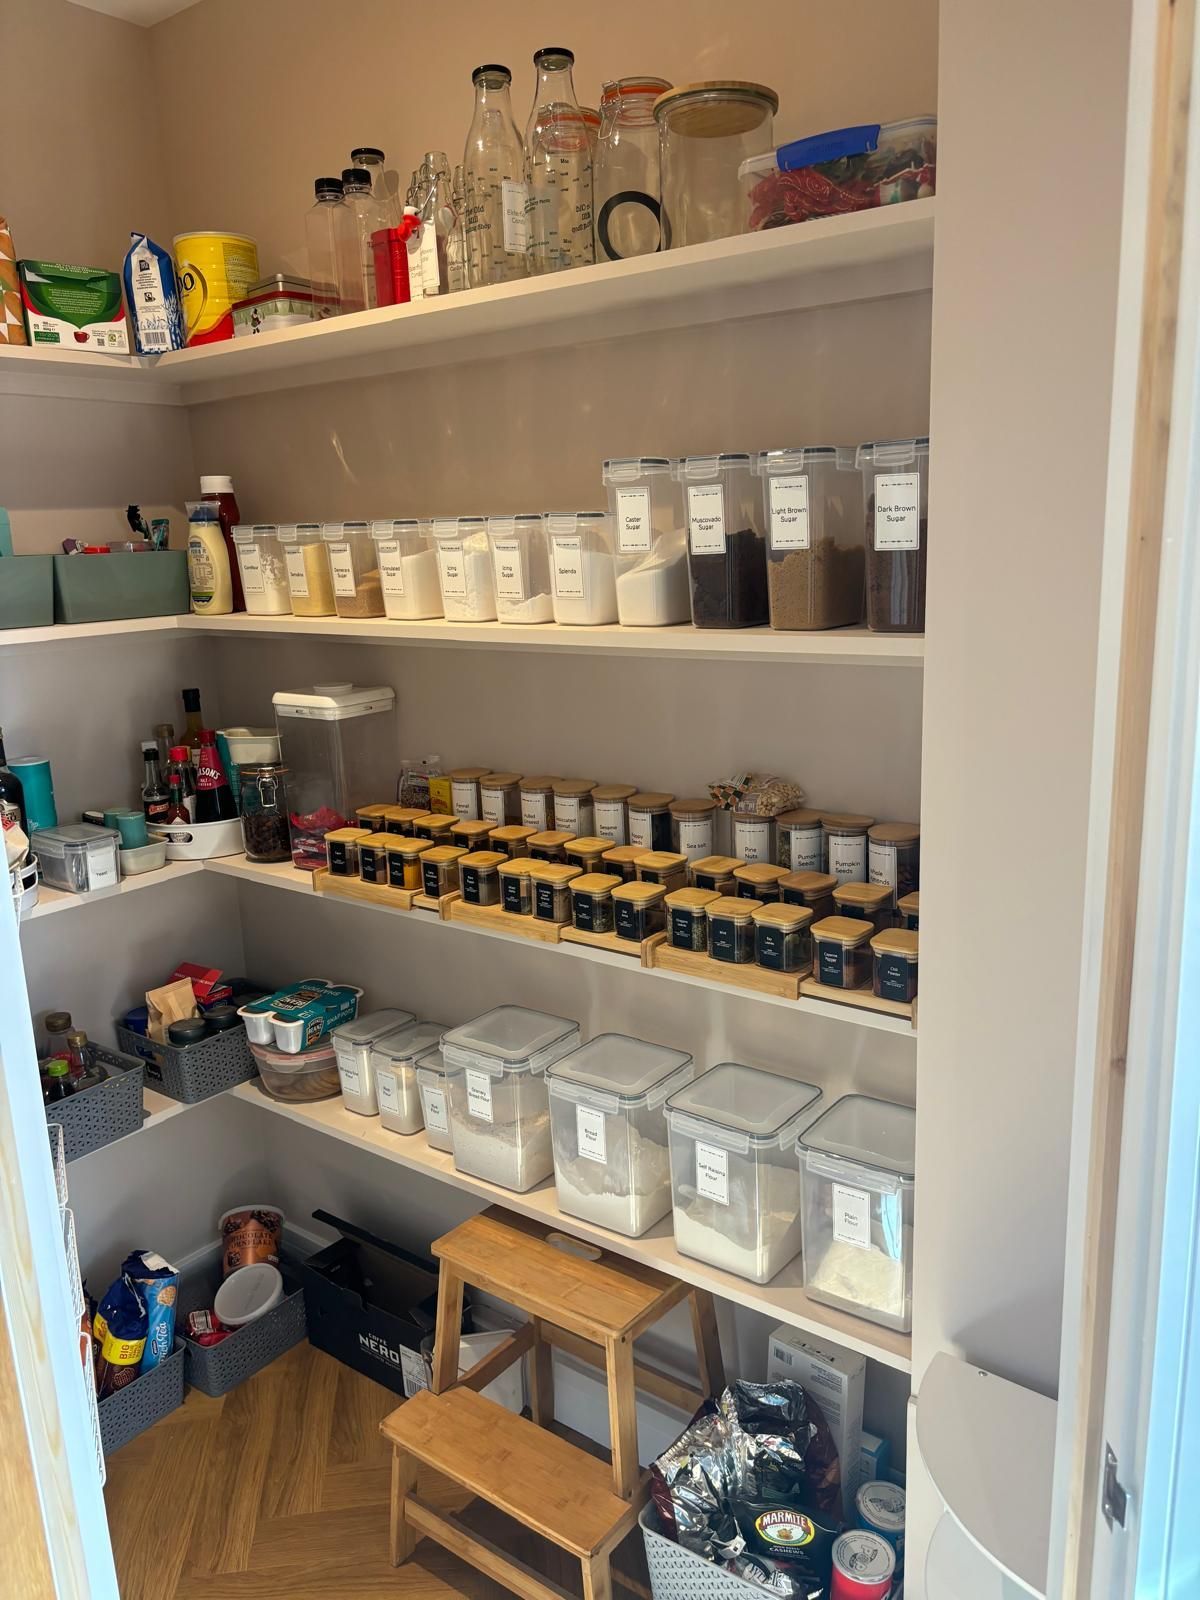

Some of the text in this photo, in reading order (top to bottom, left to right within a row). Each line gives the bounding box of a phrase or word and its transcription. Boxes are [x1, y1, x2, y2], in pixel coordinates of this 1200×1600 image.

[772, 506, 808, 515] Light Brown
[877, 504, 916, 512] Dark Brown
[625, 516, 642, 524] Caster
[691, 516, 722, 524] Muscovado
[780, 515, 798, 524] Sugar
[886, 514, 906, 523] Sugar
[558, 568, 576, 576] Splenda
[584, 1128, 598, 1137] Bread
[586, 1134, 597, 1142] Flour
[707, 1165, 726, 1178] Raising
[705, 1172, 718, 1182] Flour
[844, 1212, 858, 1221] Plain
[844, 1218, 858, 1226] Flour
[156, 1320, 167, 1341] Tea
[120, 1344, 130, 1360] BIG
[358, 1332, 400, 1364] NERO
[762, 1511, 806, 1528] MARMITE
[769, 1547, 804, 1556] CASHEWS
